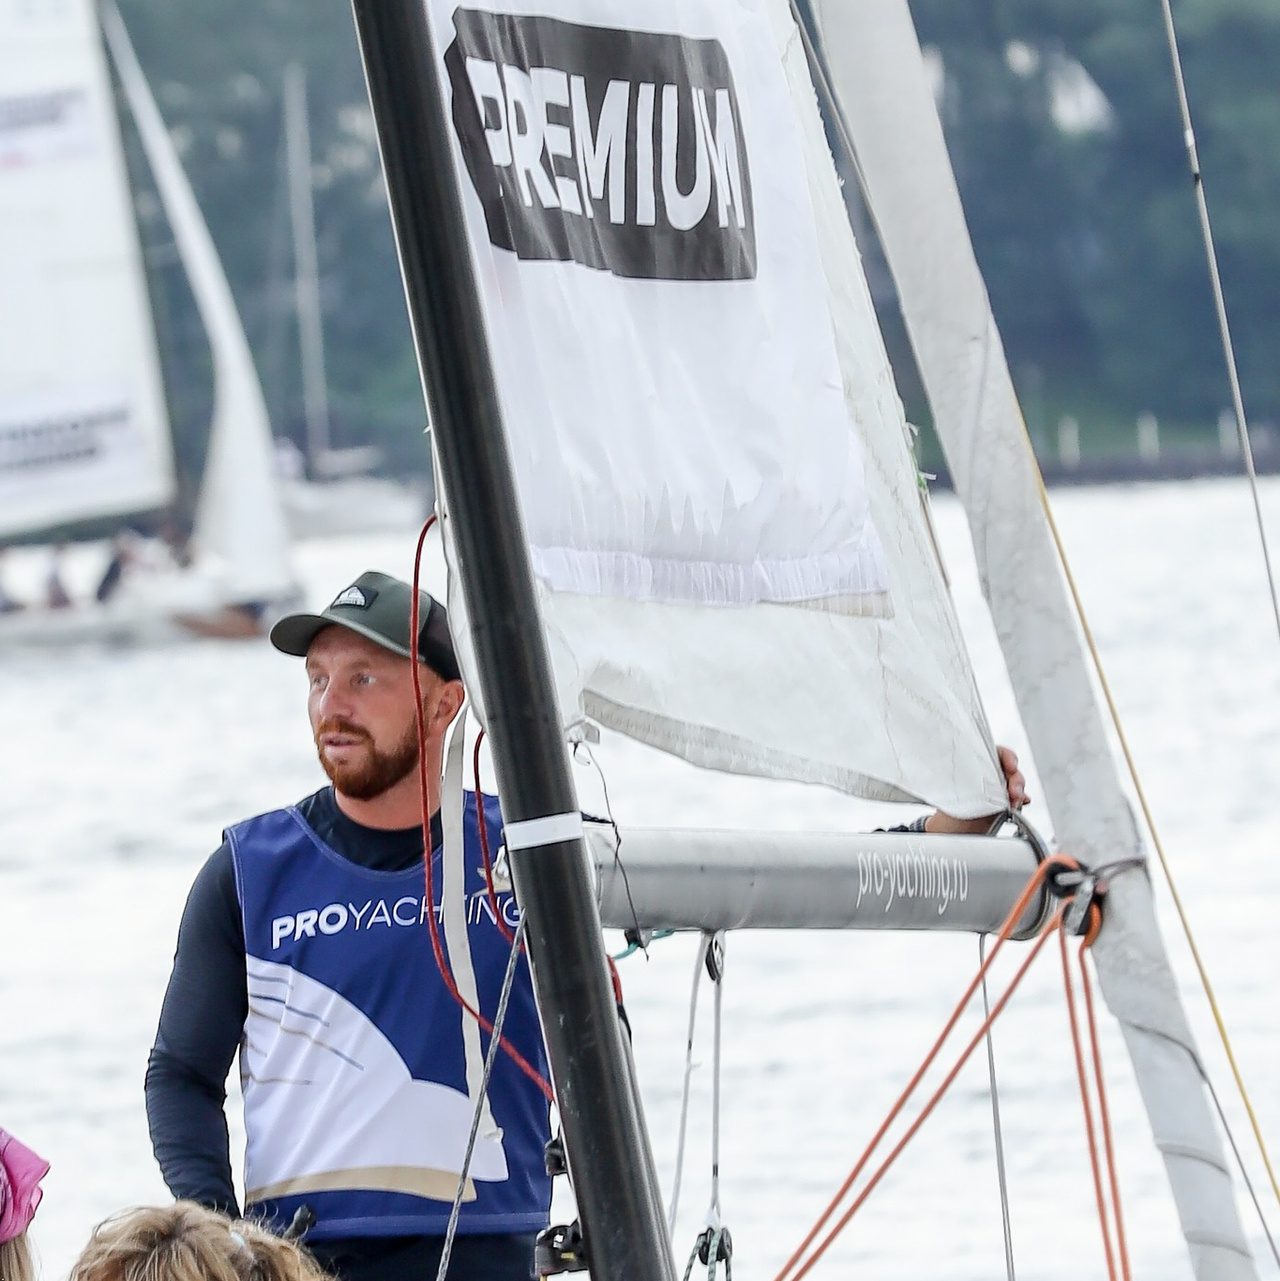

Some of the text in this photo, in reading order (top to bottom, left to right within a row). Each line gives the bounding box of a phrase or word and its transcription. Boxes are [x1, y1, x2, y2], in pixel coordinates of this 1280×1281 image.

[465, 57, 747, 231] PREMIUM
[855, 840, 968, 916] pro-yachting.ru
[272, 895, 521, 950] PROYACHING
